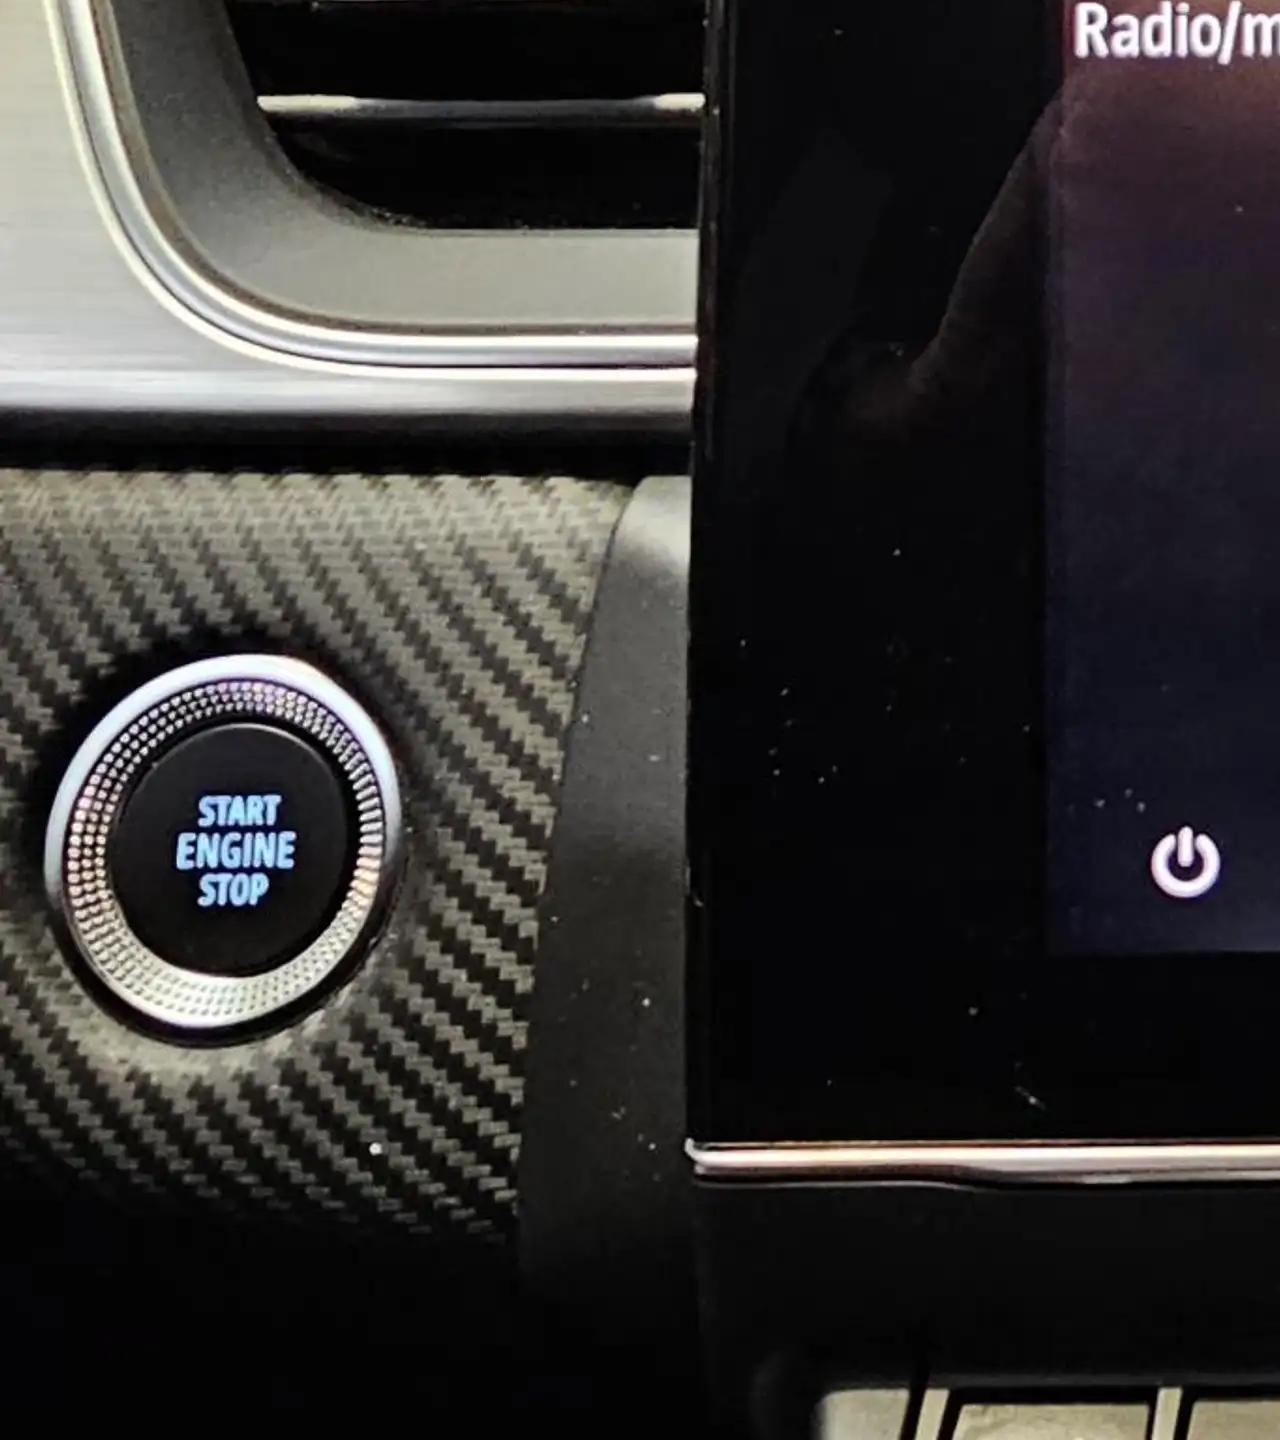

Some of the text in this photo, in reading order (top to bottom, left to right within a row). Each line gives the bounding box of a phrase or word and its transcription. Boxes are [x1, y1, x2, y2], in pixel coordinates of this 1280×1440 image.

[198, 794, 281, 827] START
[175, 831, 297, 872] ENGINE
[198, 873, 270, 907] STOP
